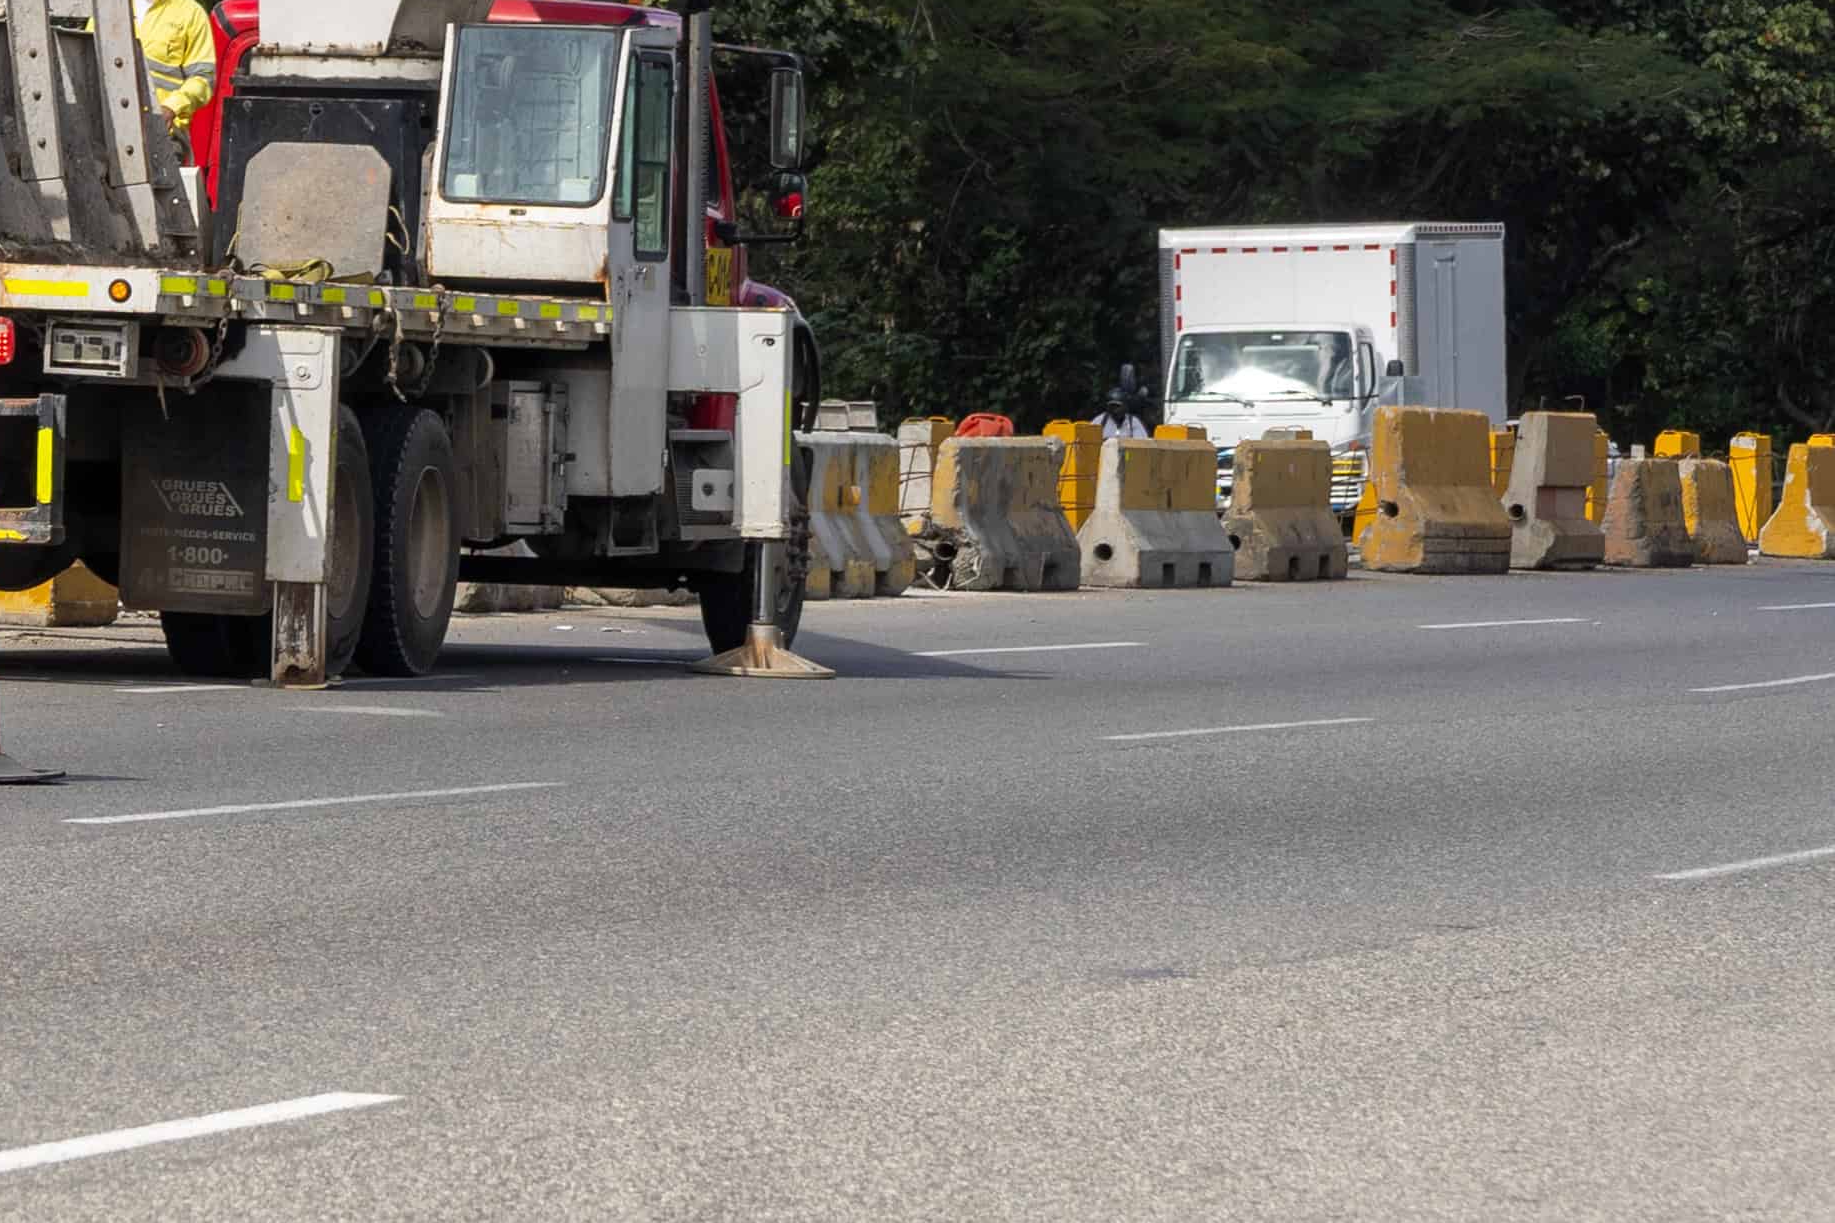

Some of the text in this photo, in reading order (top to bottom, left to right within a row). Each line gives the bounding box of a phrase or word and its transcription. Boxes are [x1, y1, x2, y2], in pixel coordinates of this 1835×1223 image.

[161, 479, 218, 493] GRUES
[170, 492, 227, 505] GRUES
[178, 503, 238, 517] GRUES
